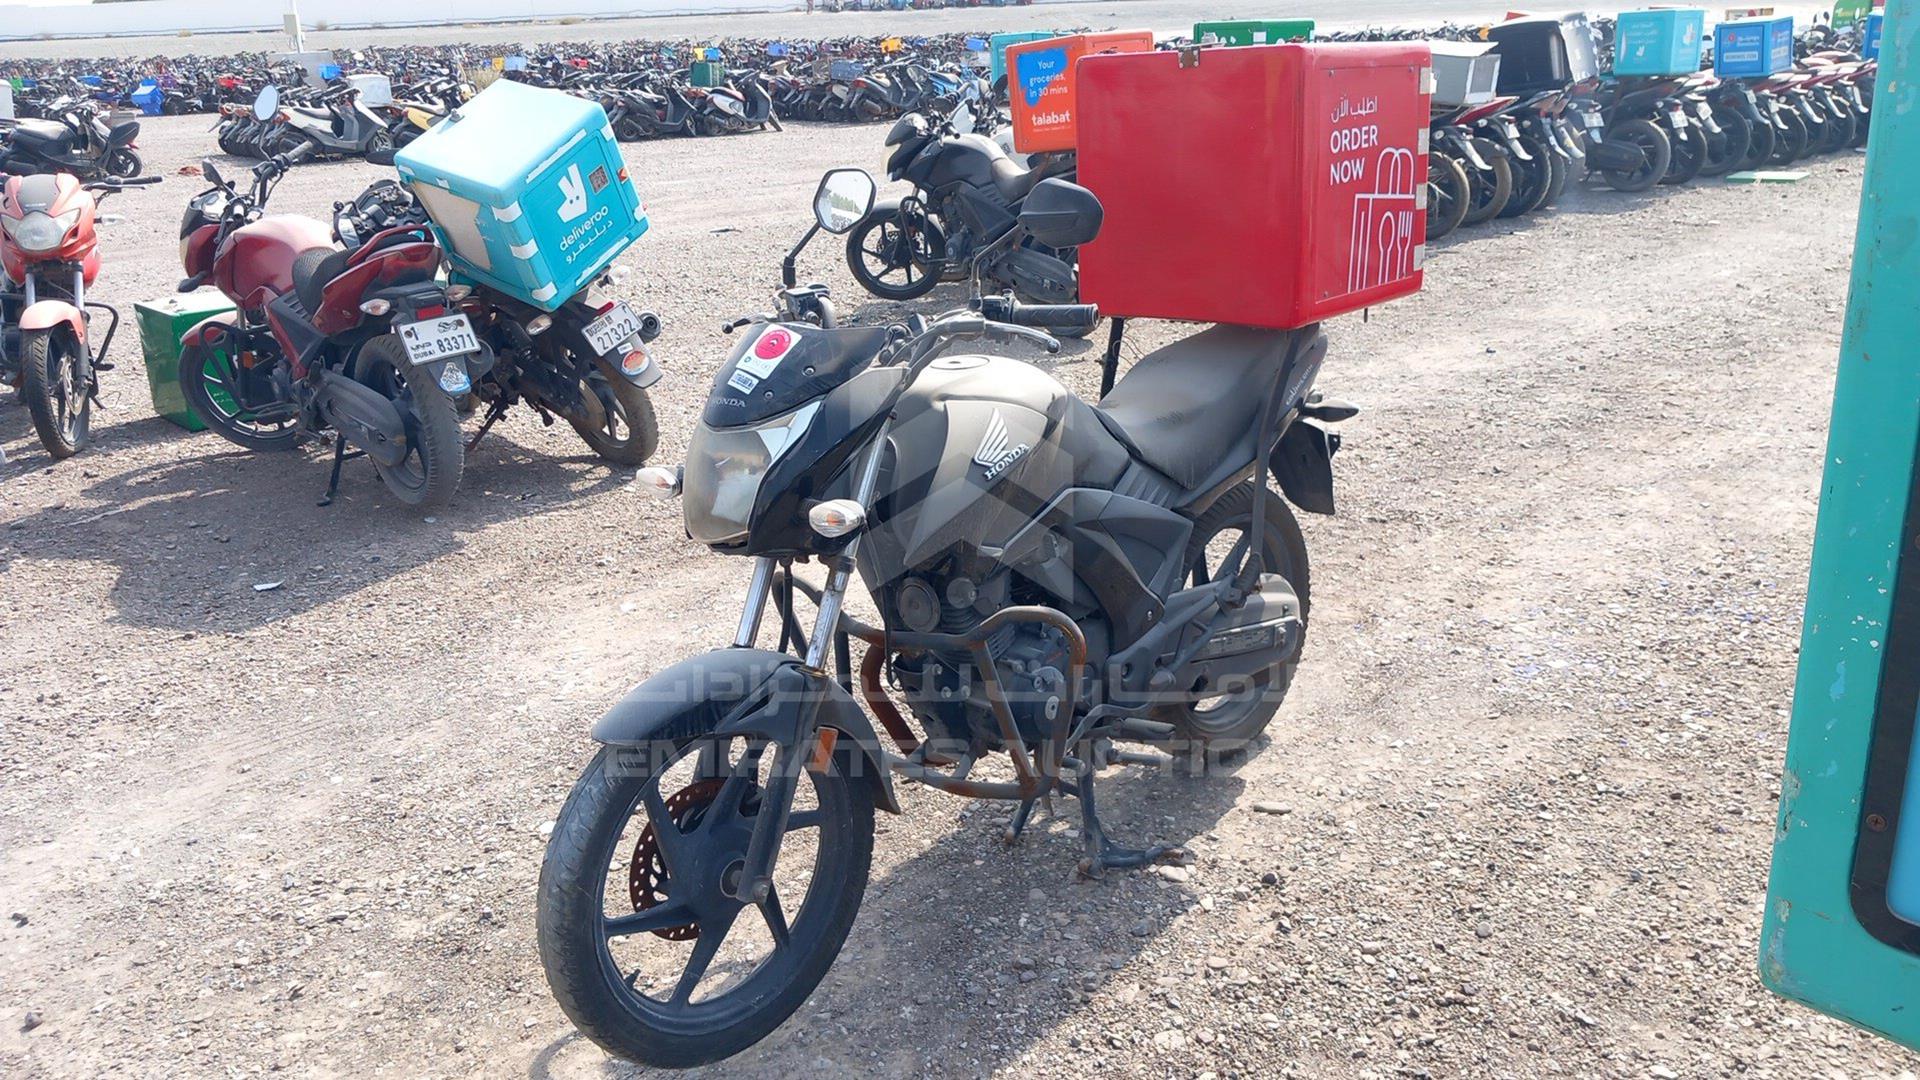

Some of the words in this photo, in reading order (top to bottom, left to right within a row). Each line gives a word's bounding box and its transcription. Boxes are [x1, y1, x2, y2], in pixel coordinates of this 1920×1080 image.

[1038, 60, 1055, 70] Your
[1029, 88, 1038, 98] in
[1038, 87, 1048, 98] 30
[1049, 85, 1068, 95] mins
[1031, 110, 1071, 127] talabat
[1350, 96, 1378, 119] اطلب
[1330, 125, 1378, 153] ORDER
[1330, 157, 1365, 186] NOW
[559, 205, 609, 251] deliveroo
[410, 326, 419, 341] 1
[436, 333, 475, 354] 83371
[597, 318, 636, 350] 27322
[413, 350, 436, 359] DUBAI
[984, 443, 1029, 480] HONDA
